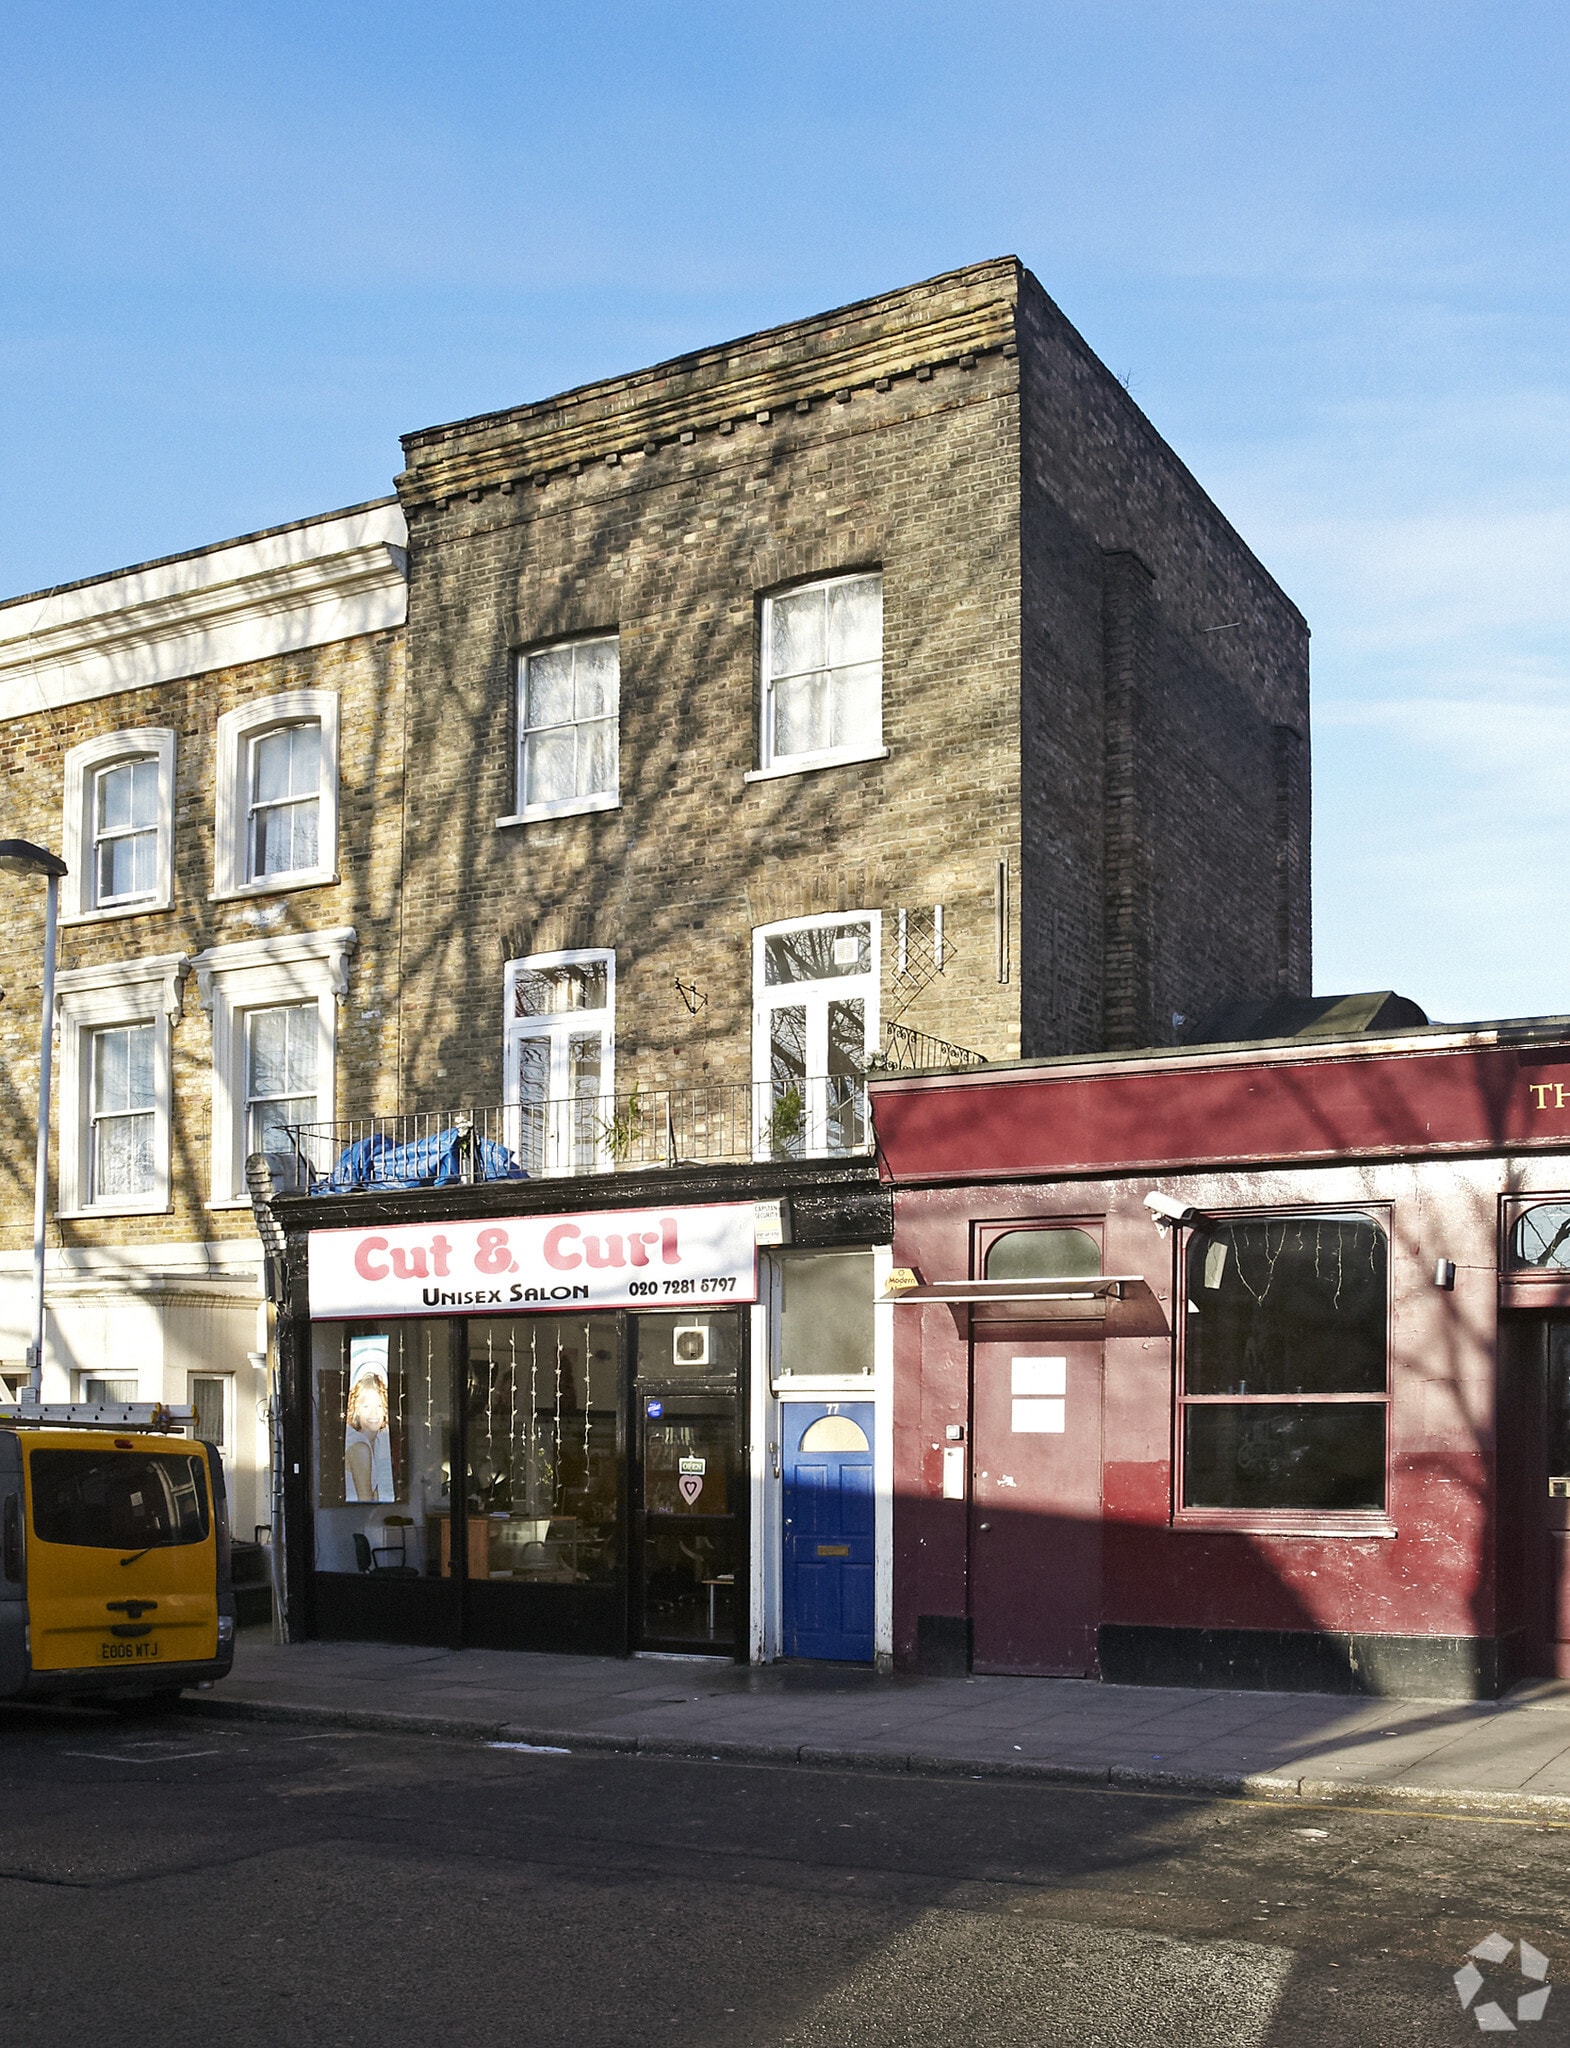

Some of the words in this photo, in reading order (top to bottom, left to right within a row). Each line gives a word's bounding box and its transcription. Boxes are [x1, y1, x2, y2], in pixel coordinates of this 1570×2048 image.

[354, 1235, 453, 1281] Cut
[474, 1228, 520, 1274] &
[543, 1217, 682, 1271] Curl
[628, 1281, 658, 1296] 020
[662, 1278, 696, 1295] 7281
[888, 1276, 916, 1285] Modern
[422, 1287, 502, 1306] UNISEX
[509, 1283, 589, 1303] SALON
[825, 1403, 840, 1415] 77
[682, 1462, 702, 1471] OPEN
